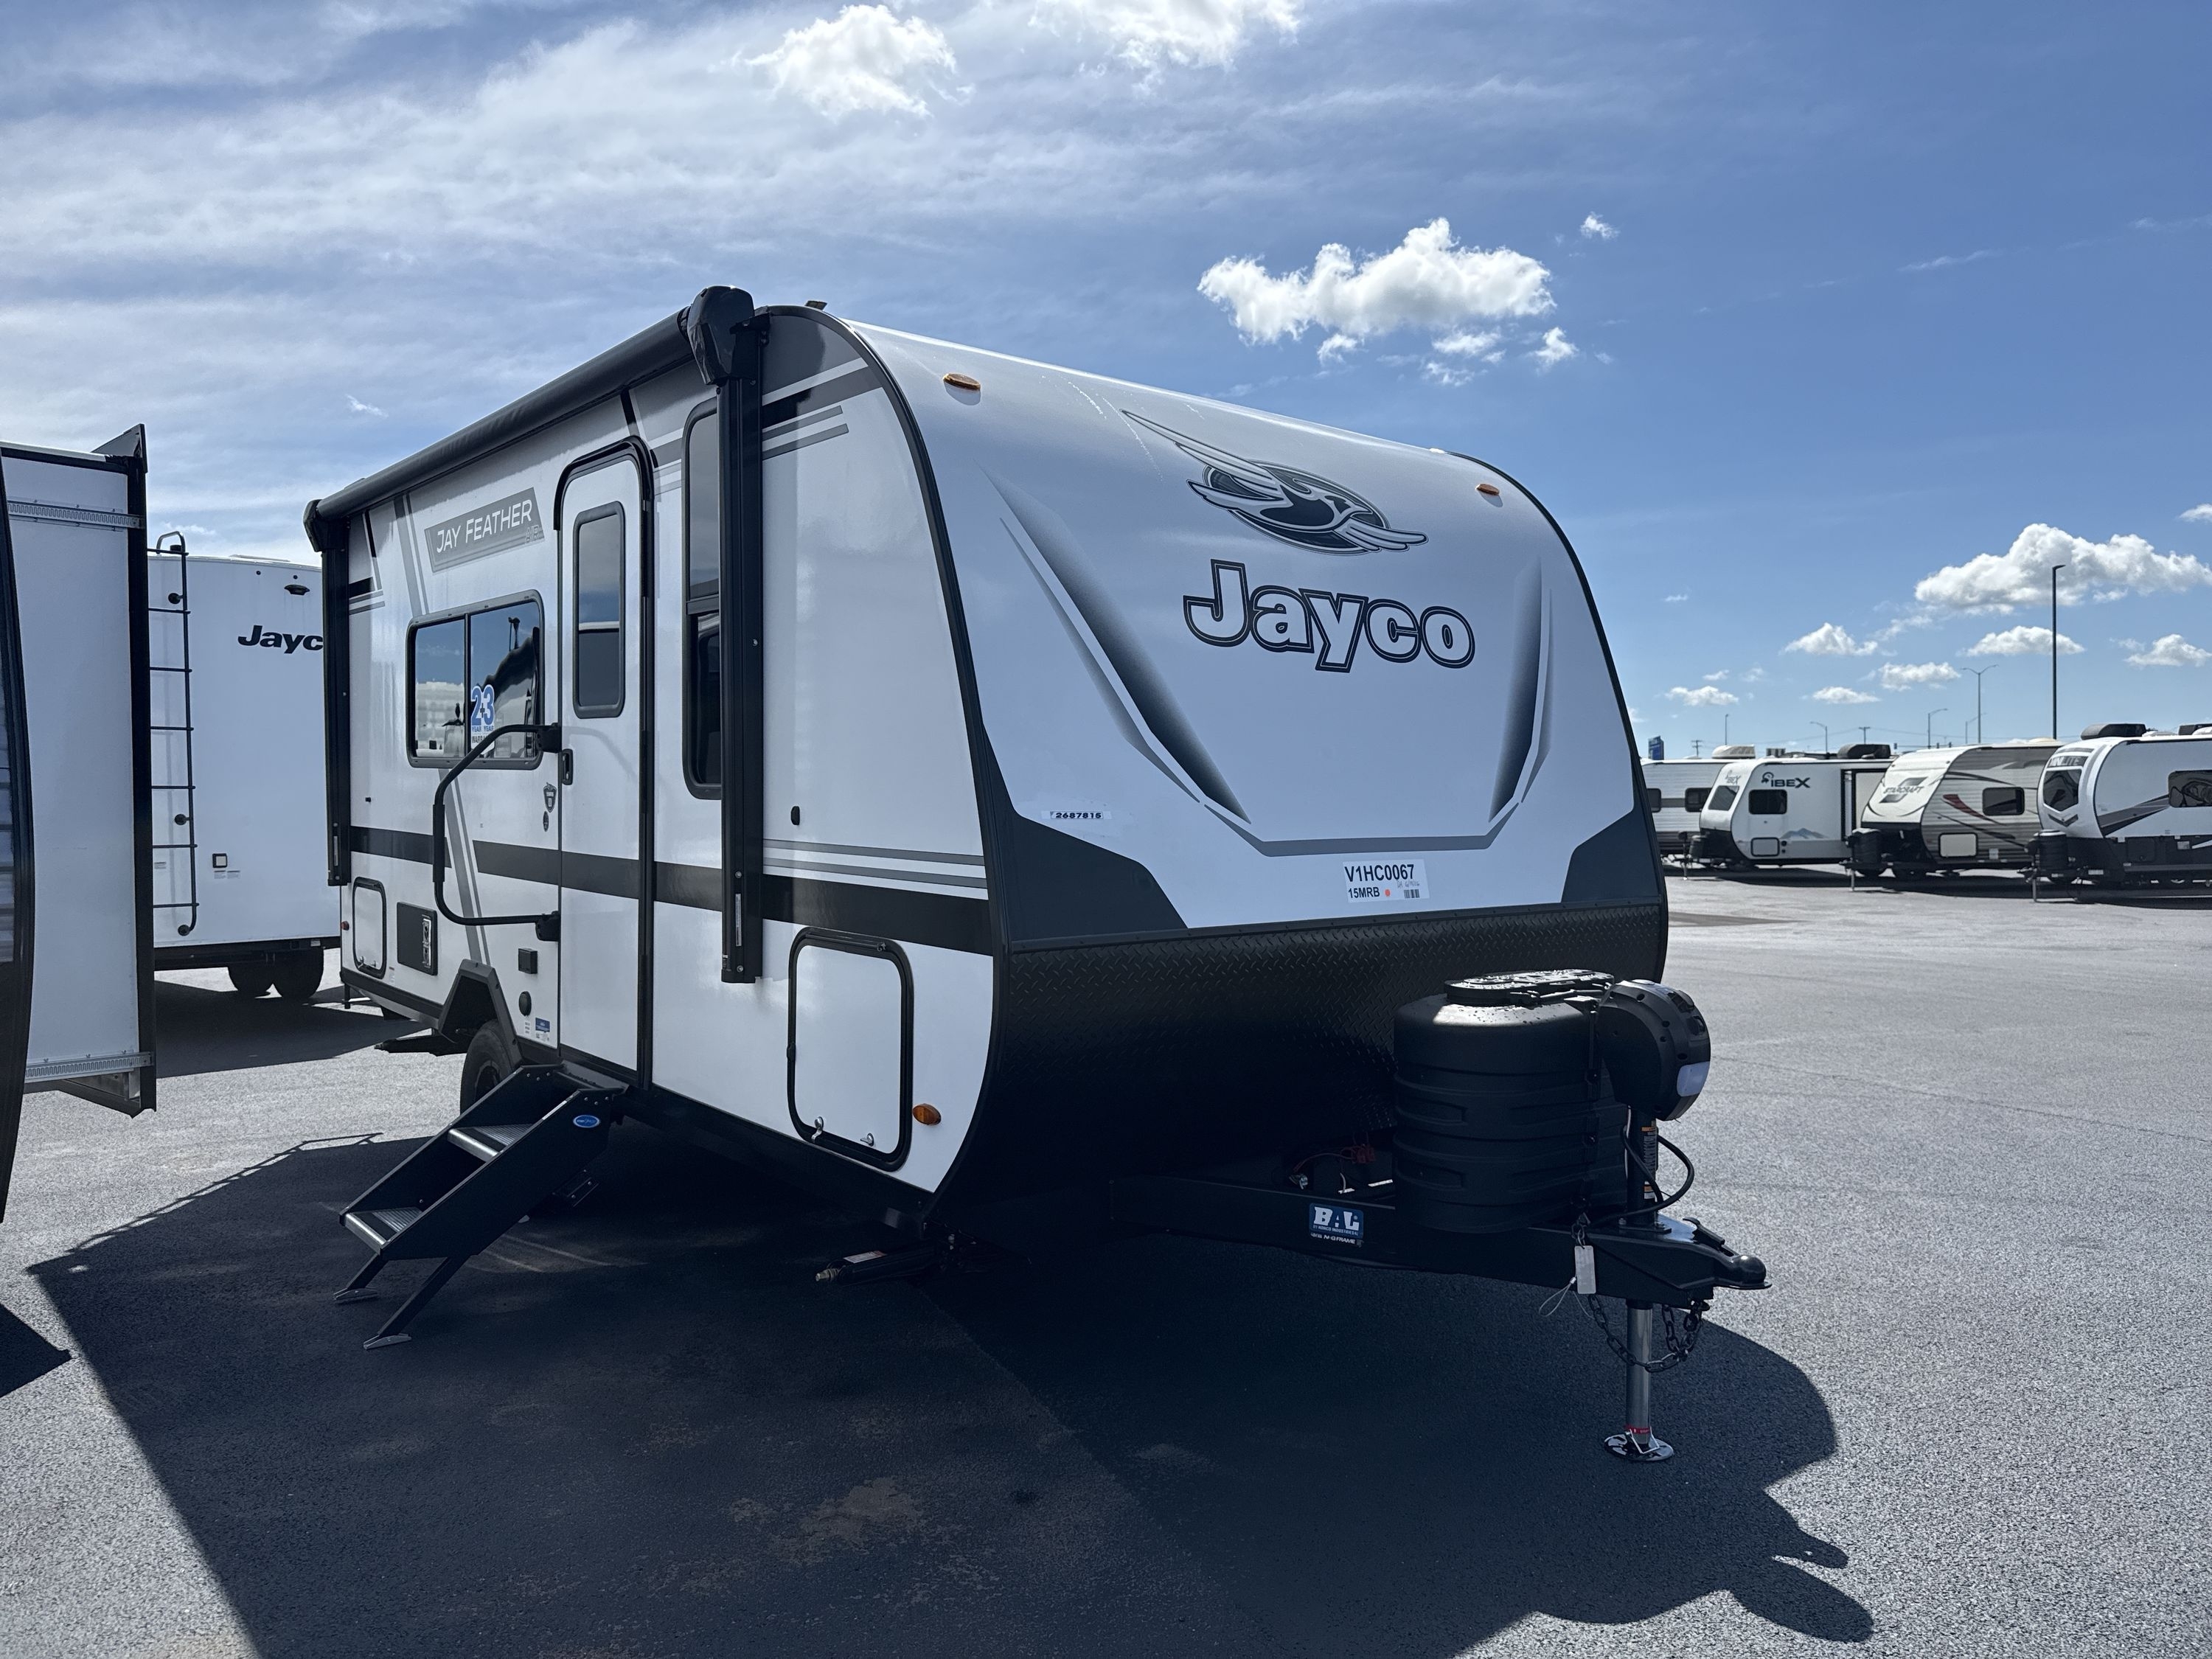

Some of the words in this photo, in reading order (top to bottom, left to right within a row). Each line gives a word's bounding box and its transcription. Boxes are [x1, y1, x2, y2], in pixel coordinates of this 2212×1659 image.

[437, 525, 461, 553] JAY
[465, 499, 532, 543] FEATHER
[1183, 559, 1475, 673] Jayco
[237, 625, 324, 654] Jayc
[1344, 863, 1415, 883] V1HC0067
[1348, 886, 1381, 899] 15MRB
[1313, 1206, 1360, 1231] BAL
